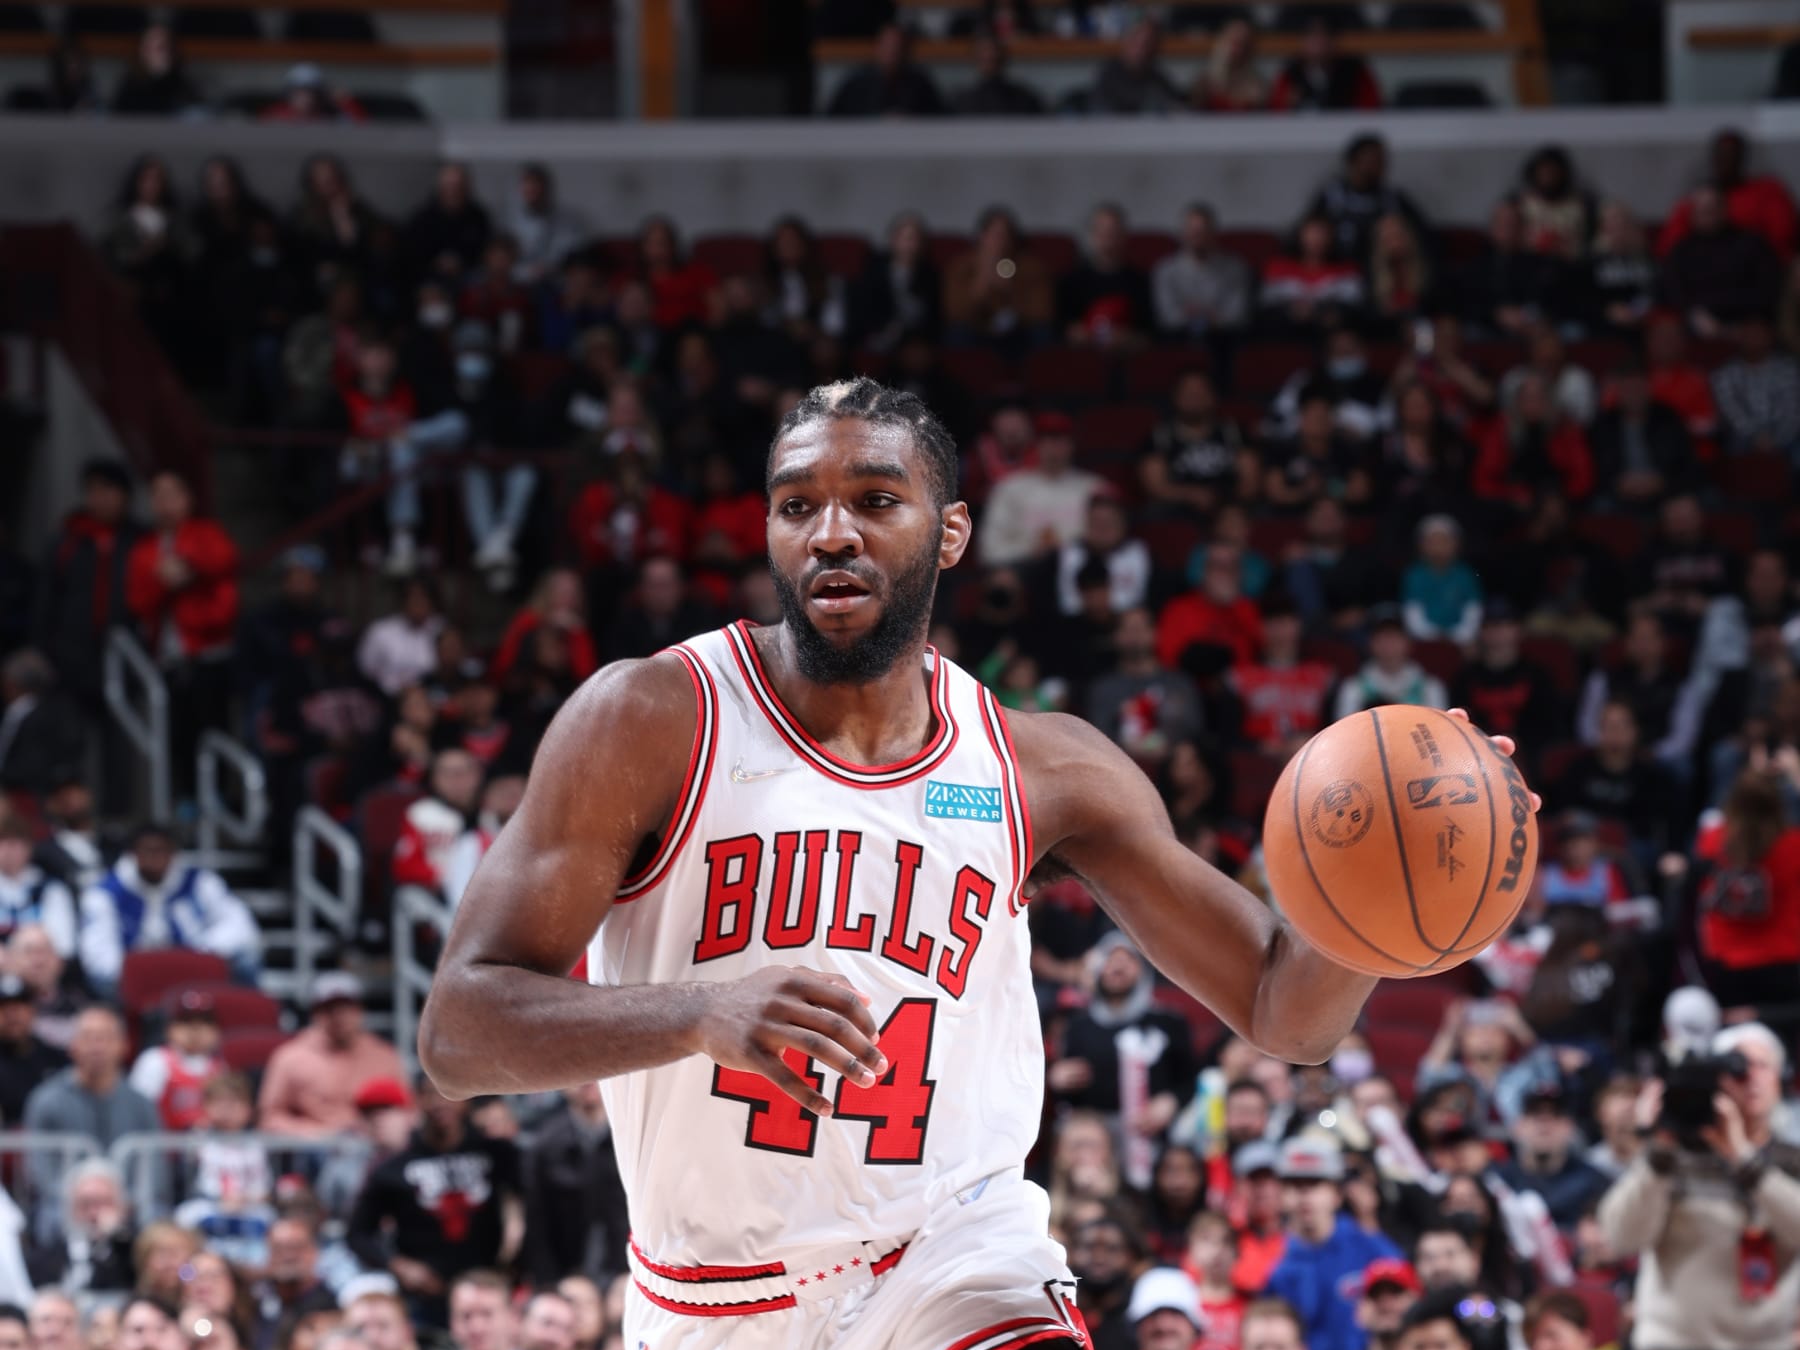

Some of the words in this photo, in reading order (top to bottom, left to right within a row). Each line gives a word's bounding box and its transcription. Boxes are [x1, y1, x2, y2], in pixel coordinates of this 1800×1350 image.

[928, 783, 1000, 806] ZENNI
[927, 803, 1000, 819] EYEWEAR
[693, 829, 996, 1000] BULLS
